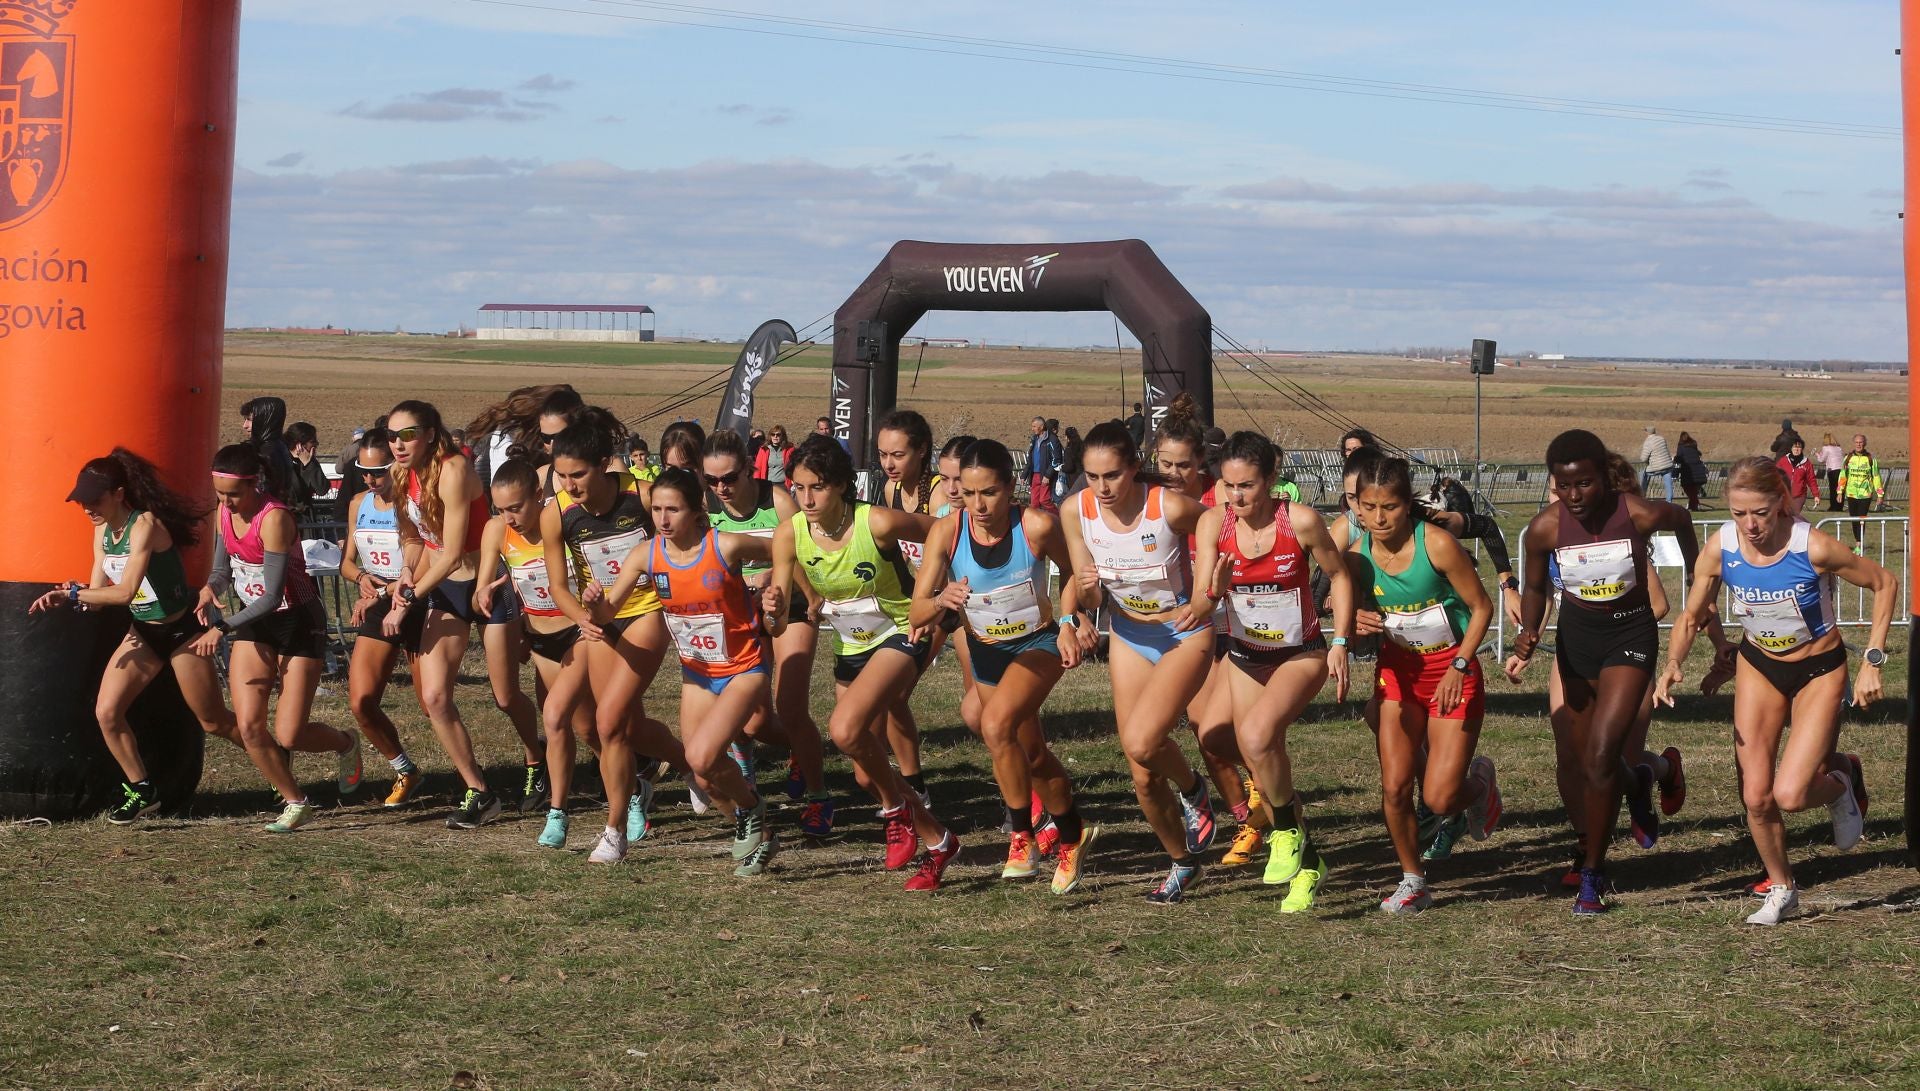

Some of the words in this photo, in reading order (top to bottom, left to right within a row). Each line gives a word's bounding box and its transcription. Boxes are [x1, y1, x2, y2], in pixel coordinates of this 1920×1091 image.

[370, 551, 391, 566] 35
[1591, 577, 1606, 587] 27
[244, 583, 266, 597] 43
[1580, 582, 1625, 596] NINTIJE
[1732, 583, 1806, 602] Piélagos
[994, 617, 1010, 626] 21
[1253, 622, 1269, 631] 23
[850, 626, 865, 634] 28
[986, 623, 1027, 636] CAMPO
[1244, 628, 1285, 640] ESPEJO
[1760, 630, 1776, 638] 22
[689, 634, 718, 650] 46
